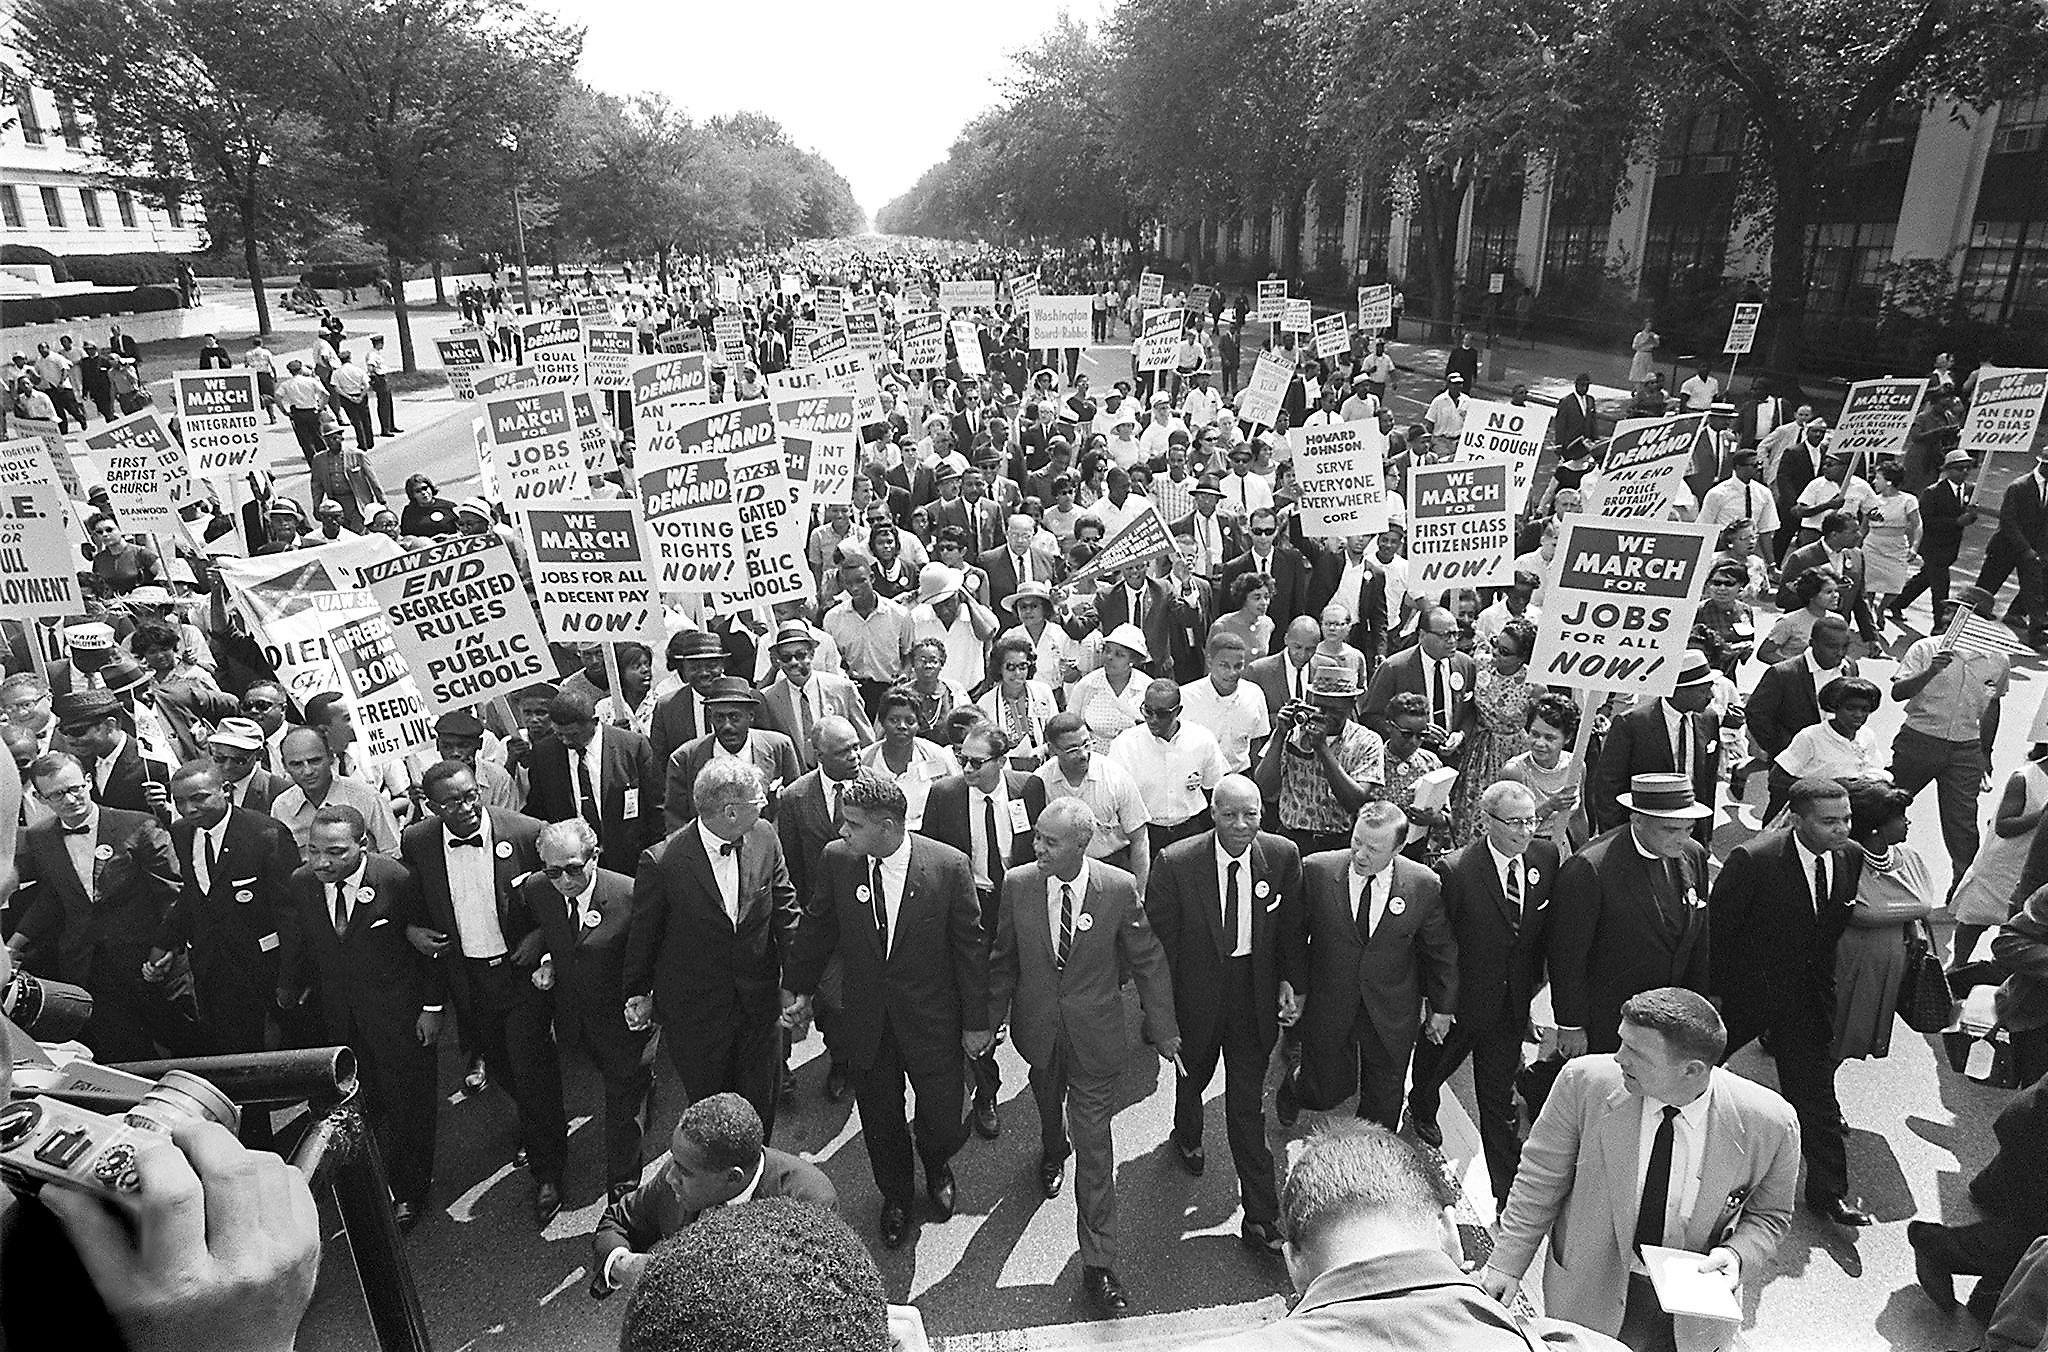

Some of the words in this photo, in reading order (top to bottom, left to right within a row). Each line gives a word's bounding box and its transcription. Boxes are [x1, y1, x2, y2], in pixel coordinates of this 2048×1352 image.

[1261, 288, 1283, 296] MARCH
[1033, 308, 1088, 324] Washington
[541, 320, 561, 334] WE
[848, 321, 876, 329] MARCH
[527, 329, 579, 349] DEMAND
[591, 338, 629, 349] MARCH
[442, 348, 480, 359] MARCH
[665, 343, 690, 354] JOBS
[535, 353, 576, 361] EQUAL
[911, 353, 941, 365] NOW!
[1146, 354, 1176, 365] NOW!
[656, 361, 681, 380] WE
[825, 360, 865, 379] I.U.E.
[204, 379, 226, 390] WE
[594, 376, 630, 386] NOW!
[639, 371, 702, 400] DEMAND
[2000, 374, 2027, 389] WE
[188, 389, 248, 406] MARCH
[1876, 386, 1896, 394] WE
[1978, 383, 2044, 403] DEMAND
[515, 399, 541, 413] WE
[797, 399, 829, 417] WE
[1853, 395, 1911, 406] MARCH
[207, 405, 232, 413] FOR
[641, 405, 664, 418] AN
[1977, 408, 1999, 417] AN
[2003, 409, 2035, 418] END
[187, 416, 257, 432] INTEGRATED
[498, 408, 564, 432] MARCH
[707, 411, 741, 438] WE
[1488, 412, 1525, 432] NO
[1840, 422, 1864, 430] CIVIL
[1977, 420, 1994, 429] TO
[1997, 420, 2030, 430] BIAS
[109, 426, 134, 442] WE
[190, 433, 259, 448] SCHOOLS
[522, 428, 548, 439] FOR
[1306, 430, 1355, 445] HOWARD
[1638, 423, 1675, 446] WE
[1971, 432, 2028, 444] NOW!
[581, 439, 606, 452] SHIP
[1464, 432, 1485, 449] U.S.
[1489, 437, 1539, 457] DOUGH
[1838, 436, 1898, 448] NOW!
[200, 447, 258, 469] NOW!
[507, 440, 569, 467] JOBS
[1608, 433, 1692, 469] DEMAND
[111, 457, 147, 468] FIRST
[511, 468, 539, 479] FOR
[548, 462, 570, 472] ALL
[819, 463, 848, 476] ING
[1316, 460, 1353, 474] SERVE
[1514, 461, 1525, 473] P
[107, 470, 156, 481] BAPTIST
[666, 464, 698, 489] WE
[1447, 472, 1474, 485] WE
[1609, 470, 1638, 481] AN
[1640, 466, 1673, 480] END
[111, 483, 157, 493] CHURCH
[515, 472, 577, 499] NOW!
[1303, 474, 1375, 492] EVERYONE
[1513, 476, 1526, 488] W
[1619, 483, 1656, 495] POLICE
[648, 479, 730, 515] DEMAND
[1301, 491, 1381, 508] EVERYWHERE
[1422, 483, 1499, 506] MARCH
[1604, 491, 1660, 506] BRUTALITY
[739, 499, 787, 524] GATED
[1445, 503, 1476, 514] FOR
[563, 514, 597, 530] WE
[1323, 511, 1358, 524] CORE
[652, 522, 734, 538] VOTING
[1415, 522, 1455, 538] FIRST
[1461, 518, 1507, 534] CLASS
[541, 531, 630, 550] MARCH
[1412, 536, 1508, 554] CITIZENSHIP
[1617, 535, 1657, 554] WE
[372, 552, 420, 581] UAW
[428, 535, 496, 563] SAYS:
[571, 550, 606, 561] FOR
[661, 543, 733, 558] RIGHTS
[662, 560, 735, 582] NOW!
[1422, 555, 1502, 581] NOW!
[1573, 553, 1687, 580] MARCH
[401, 559, 485, 599] END
[540, 571, 579, 585] JOBS
[582, 570, 614, 584] FOR
[617, 569, 648, 583] ALL
[1603, 579, 1647, 592] FOR
[388, 573, 516, 625] SEGREGATED
[543, 591, 556, 603] A
[557, 591, 616, 603] DECENT
[619, 590, 650, 603] PAY
[415, 600, 507, 641] RULES
[561, 609, 648, 632] NOW!
[1561, 601, 1671, 632] JOBS
[454, 632, 485, 651] IN
[1560, 631, 1605, 645] FOR
[1618, 636, 1659, 649] ALL
[427, 633, 530, 680] PUBLIC
[1548, 651, 1665, 682] NOW!
[432, 655, 543, 704] SCHOOLS
[368, 728, 385, 741] WE
[368, 738, 400, 757] MUST
[400, 717, 437, 747] LIVE
